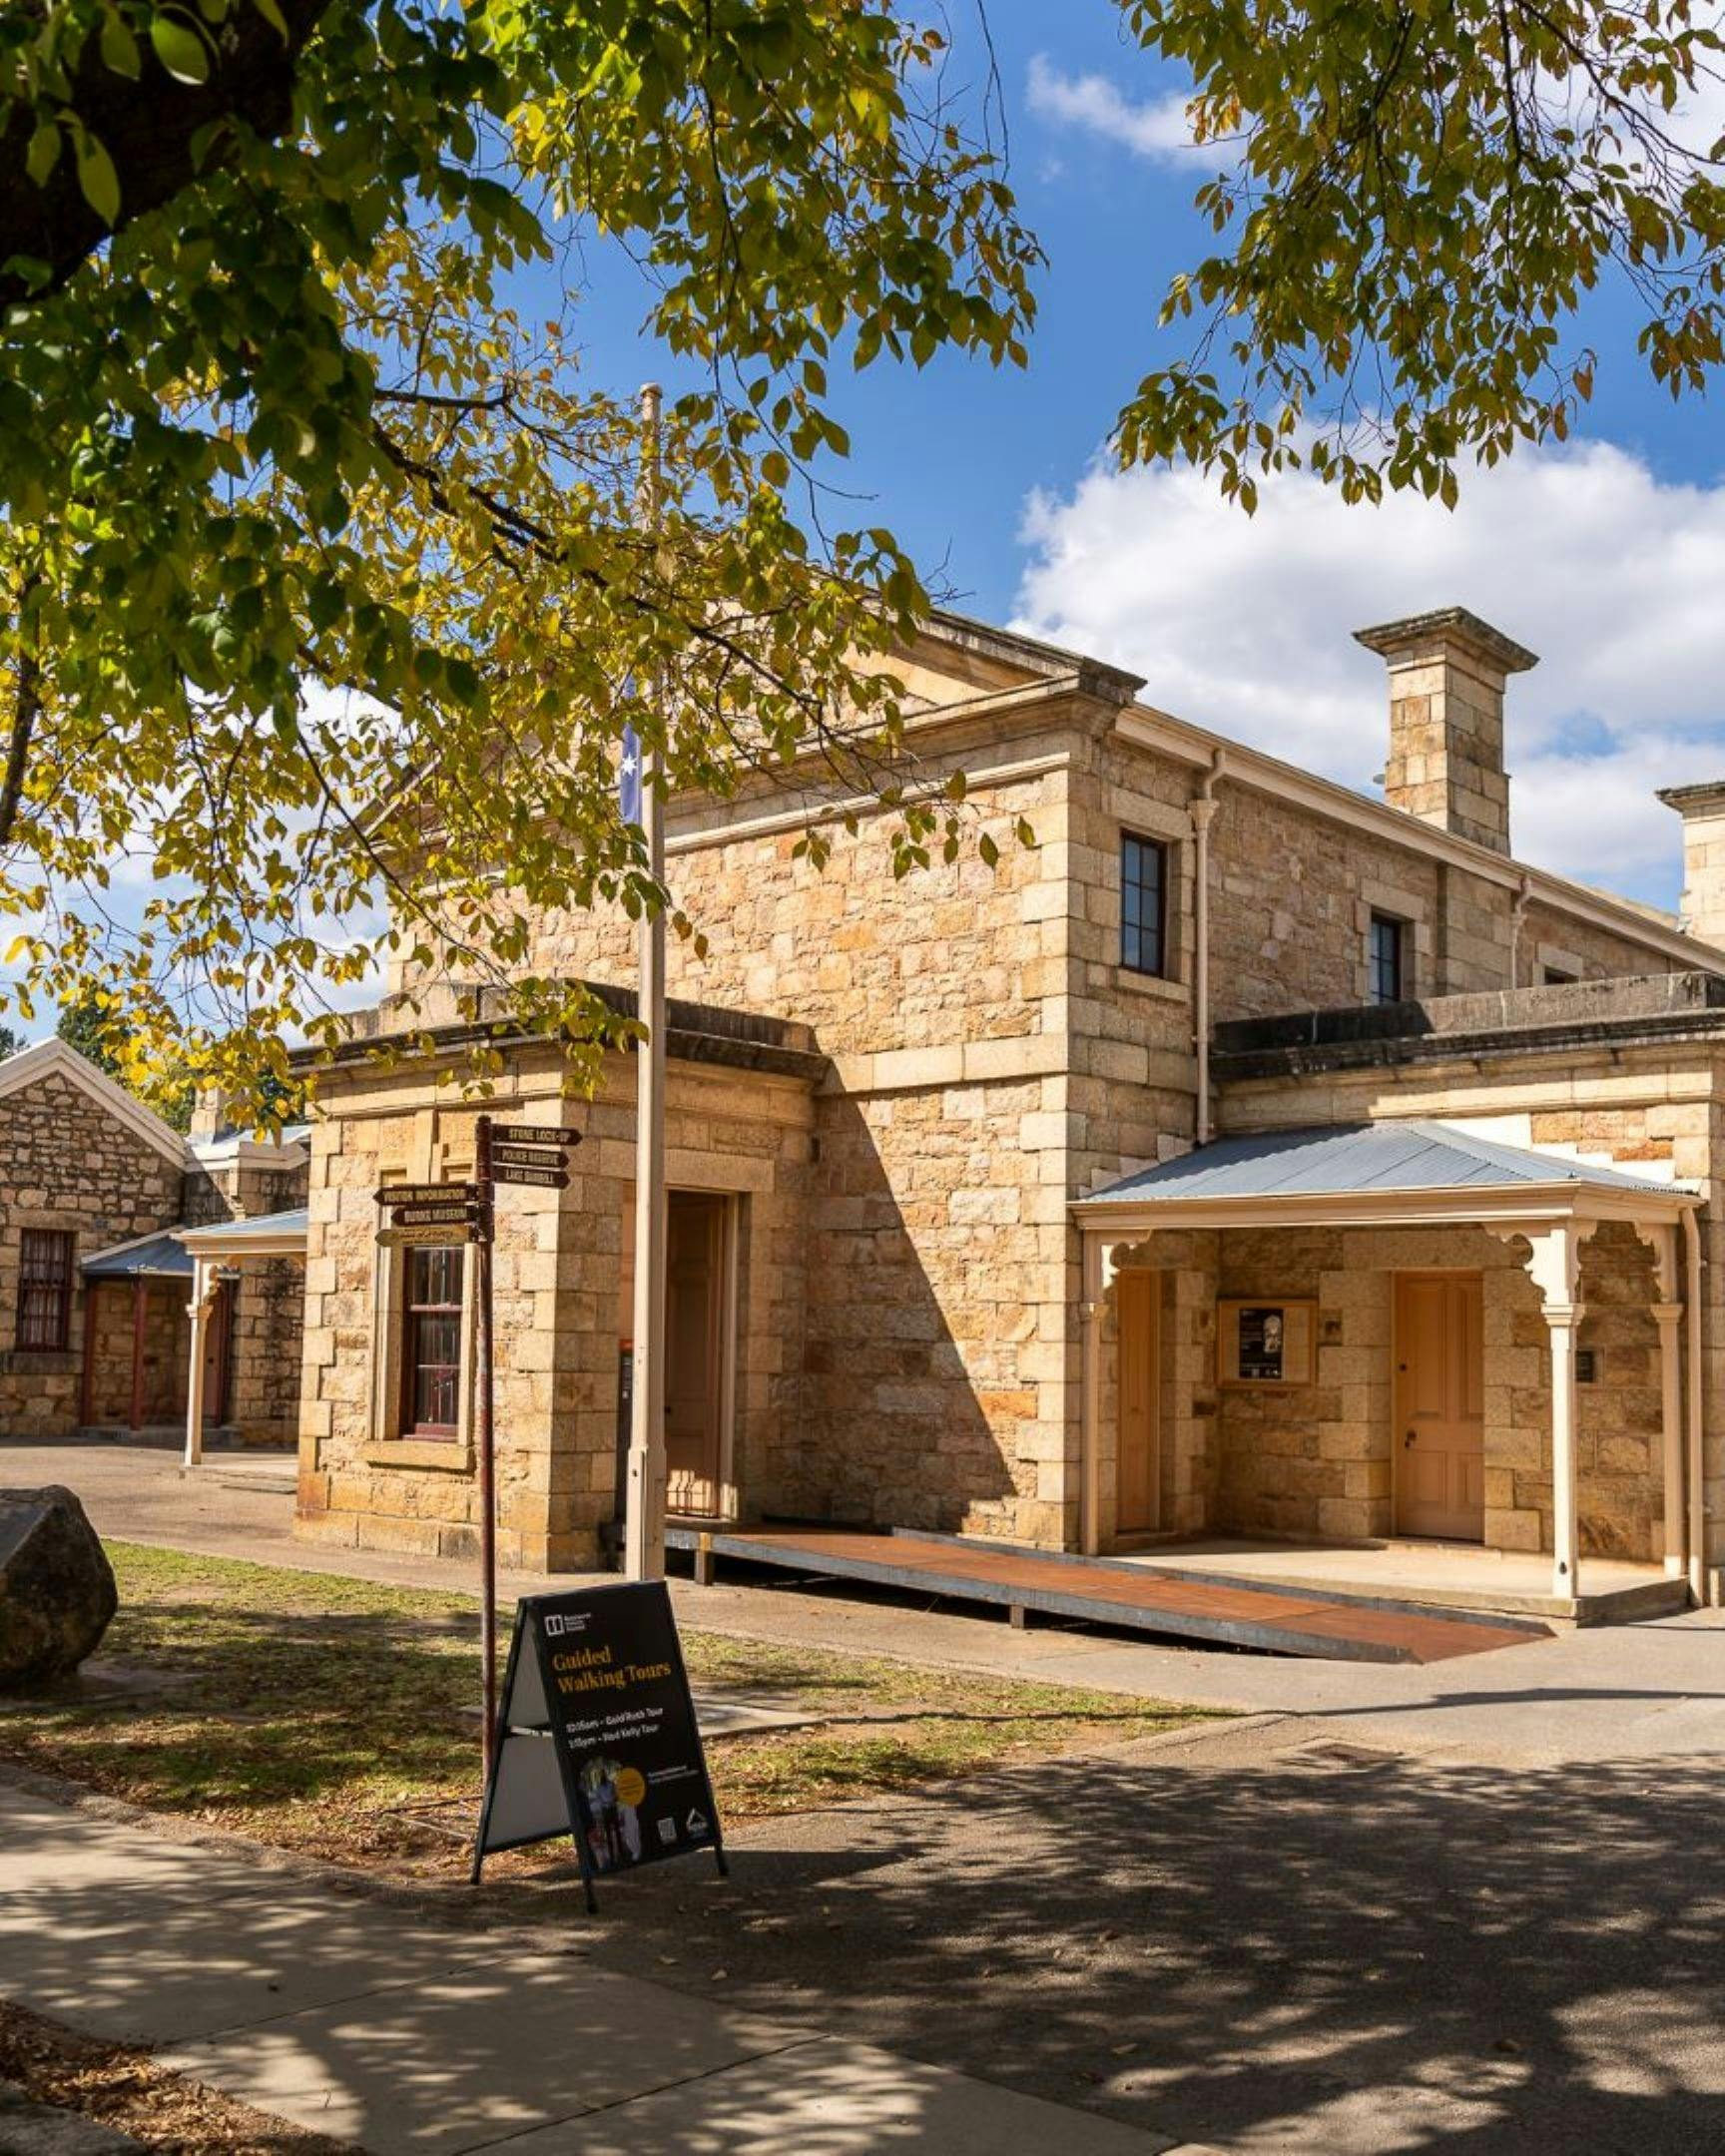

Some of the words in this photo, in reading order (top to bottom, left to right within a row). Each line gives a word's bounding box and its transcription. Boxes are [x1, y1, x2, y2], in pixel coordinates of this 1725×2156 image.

[552, 1645, 611, 1671] Guided
[557, 1670, 626, 1693] Walking
[624, 1661, 671, 1682] Tours
[646, 1707, 664, 1718] Tour
[641, 1724, 659, 1734] Tour
